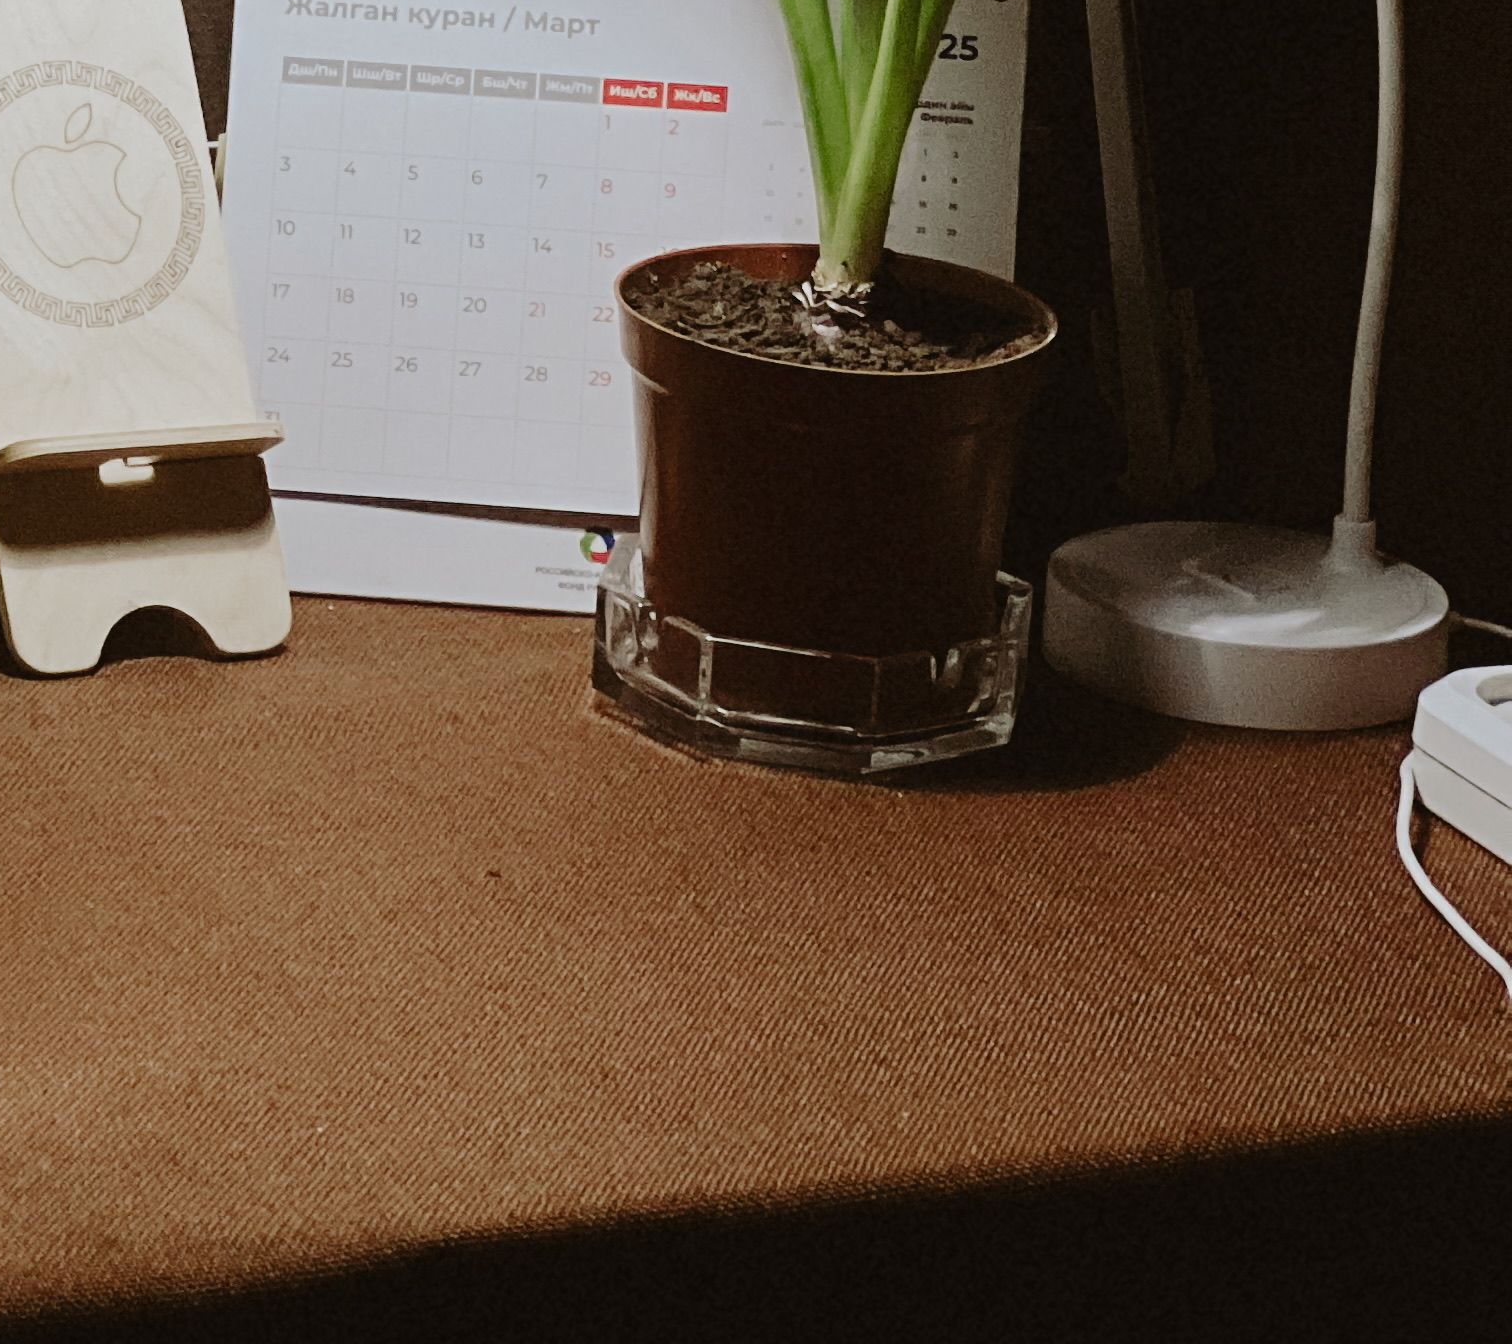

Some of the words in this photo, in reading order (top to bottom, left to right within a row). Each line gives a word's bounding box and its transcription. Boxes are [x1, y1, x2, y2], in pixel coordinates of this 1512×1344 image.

[407, 5, 496, 31] куран
[523, 9, 602, 40] Март
[416, 70, 466, 87] Шр/Ср
[609, 84, 658, 100] Иш/Сб
[604, 114, 612, 131] 1
[667, 118, 680, 137] 2
[279, 155, 292, 173] 3
[343, 160, 357, 177] 4
[407, 164, 419, 182] 5
[470, 169, 484, 186] 6
[535, 172, 549, 190] 7
[599, 177, 614, 195] 8
[663, 182, 677, 200] 9
[275, 218, 297, 237] 10
[339, 223, 354, 241] 11
[403, 227, 422, 246] 12
[467, 232, 486, 250] 13
[531, 236, 553, 254] 14
[595, 240, 616, 260] 15
[271, 282, 291, 299] 17
[335, 287, 355, 305] 18
[399, 291, 419, 309] 19
[461, 296, 488, 314] 20
[527, 300, 547, 319] 21
[591, 305, 615, 324] 22
[266, 346, 292, 364] 24
[330, 350, 354, 369] 25
[393, 355, 419, 374] 26
[458, 360, 483, 377] 27
[523, 364, 549, 383] 28
[587, 369, 613, 388] 29
